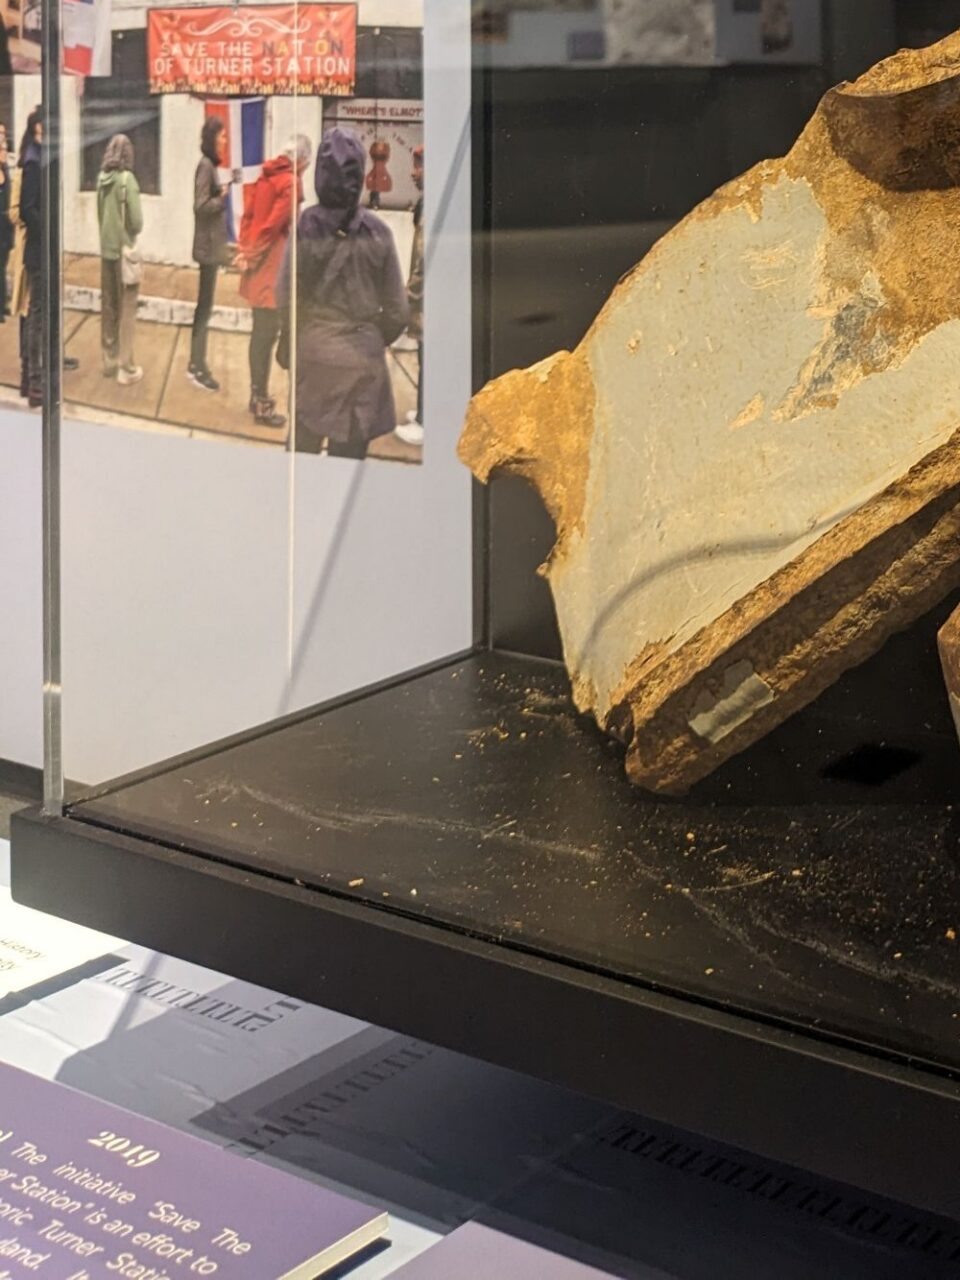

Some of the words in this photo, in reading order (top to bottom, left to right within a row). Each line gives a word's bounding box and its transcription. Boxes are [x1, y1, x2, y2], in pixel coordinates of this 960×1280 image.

[154, 60, 175, 76] OF
[184, 57, 254, 76] TURNER
[261, 55, 351, 77] STATION
[160, 41, 209, 57] SAVE
[217, 40, 254, 57] THE
[262, 39, 344, 56] NATON
[87, 1130, 161, 1168] 2019
[10, 1141, 48, 1165] The
[52, 1161, 137, 1205] initiative
[211, 1227, 252, 1256] The
[37, 1219, 105, 1258] Turner
[83, 1206, 108, 1225] is
[102, 1219, 134, 1238] an
[131, 1232, 194, 1265] effort
[189, 1255, 218, 1275] to
